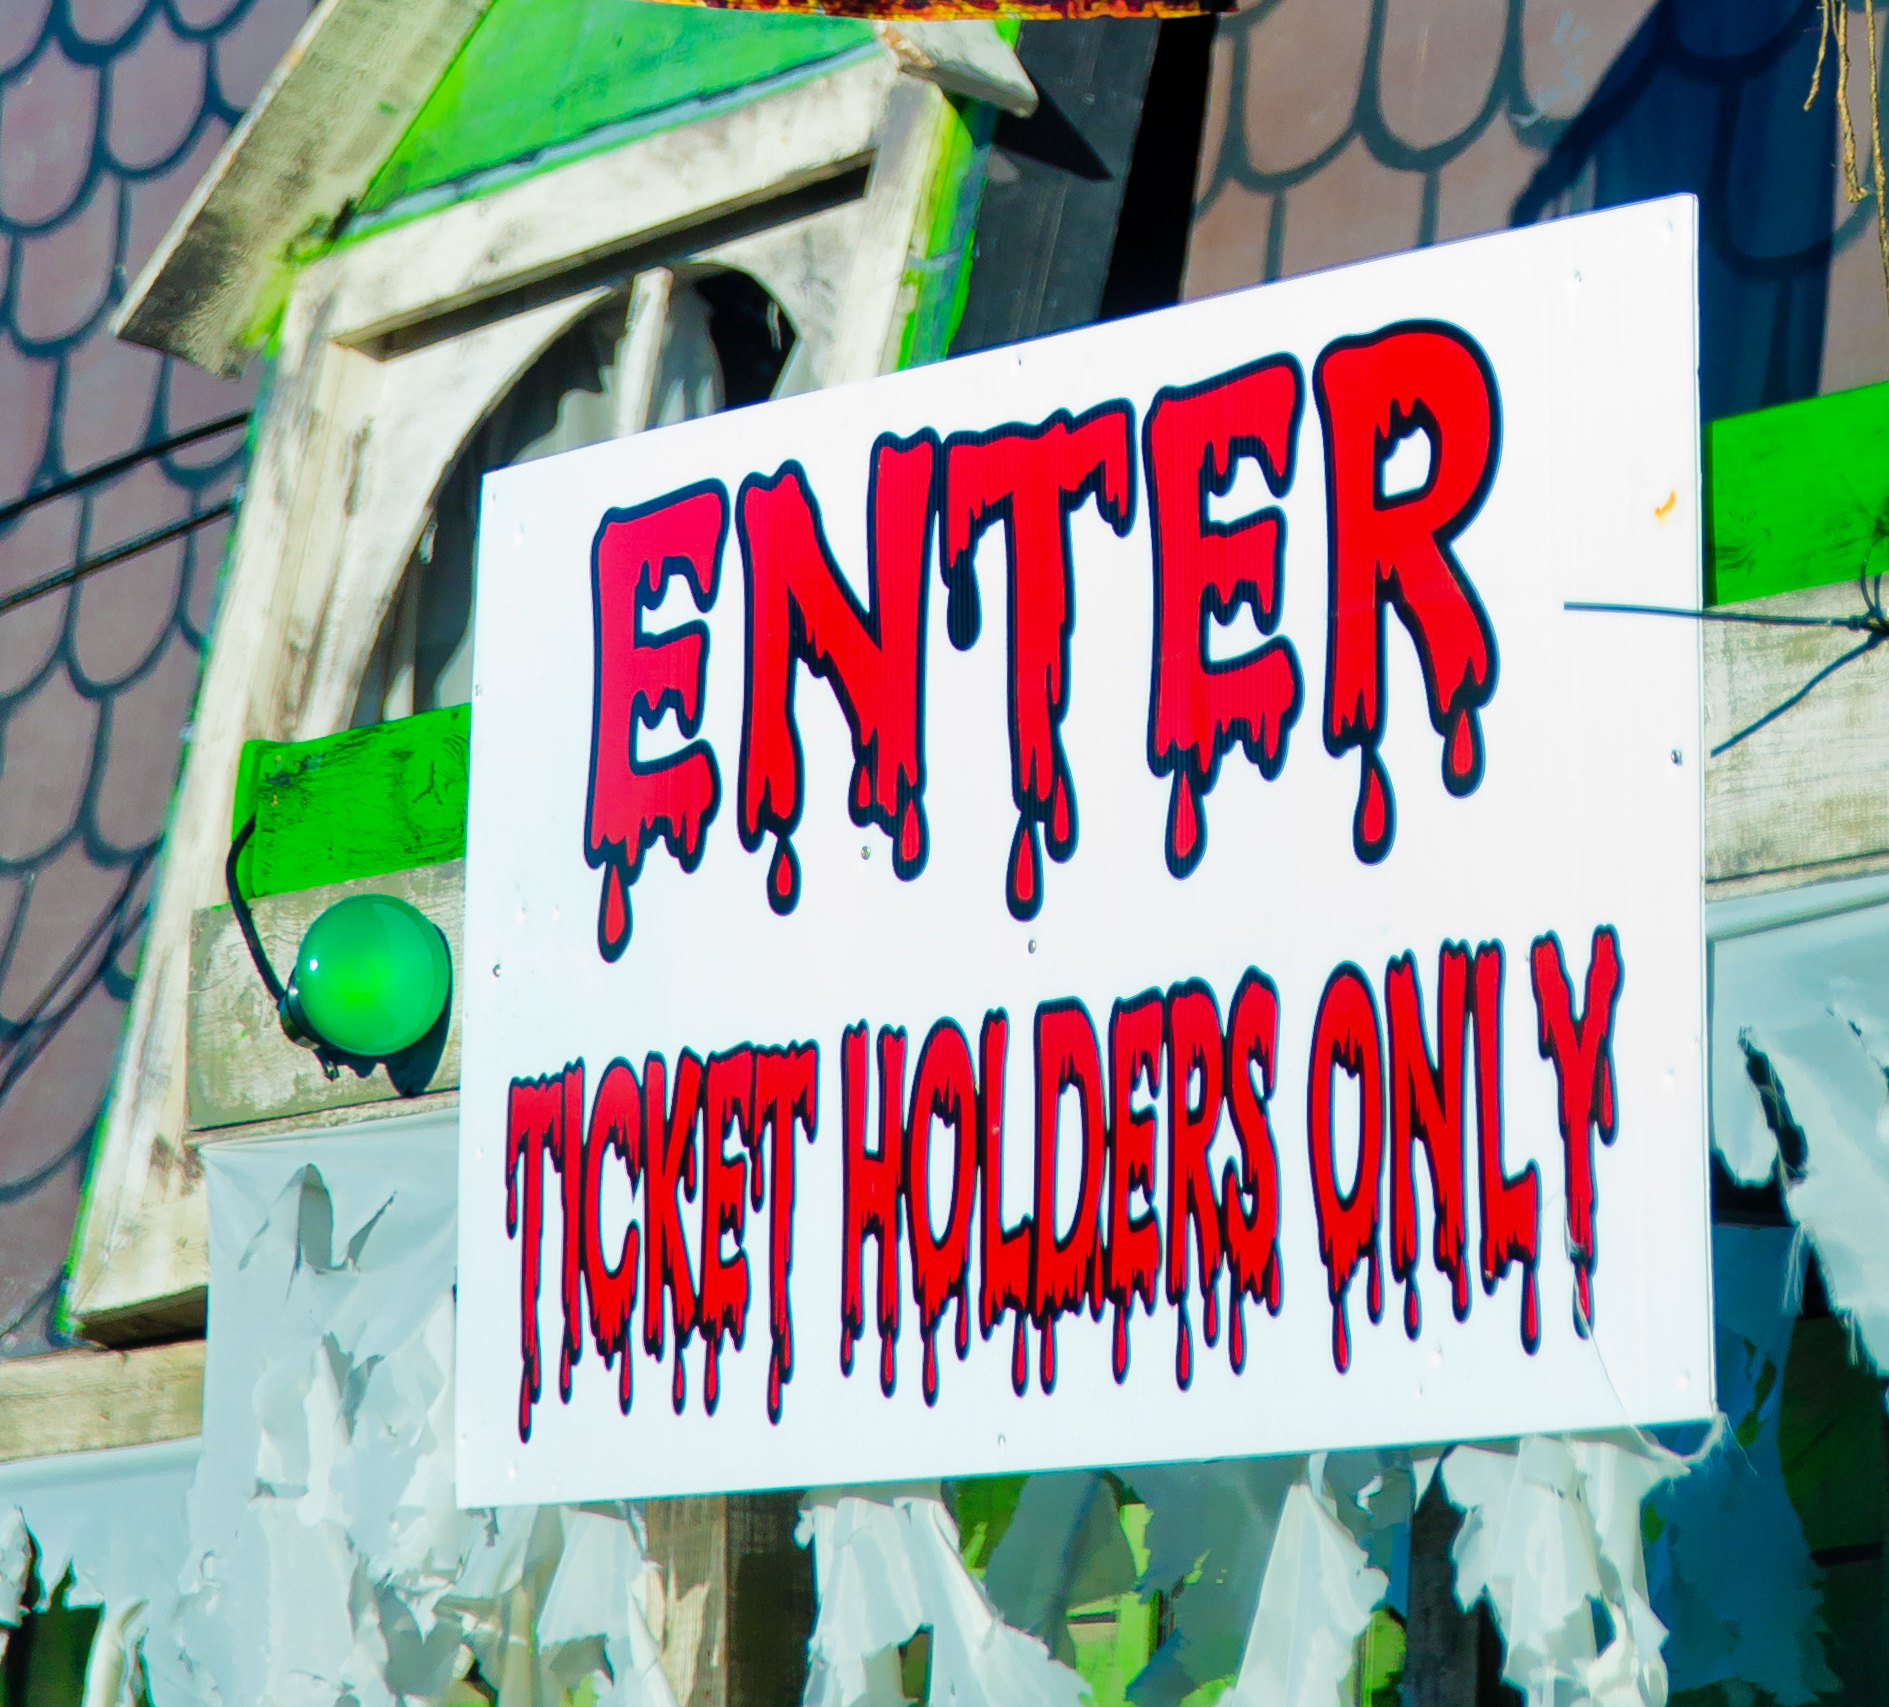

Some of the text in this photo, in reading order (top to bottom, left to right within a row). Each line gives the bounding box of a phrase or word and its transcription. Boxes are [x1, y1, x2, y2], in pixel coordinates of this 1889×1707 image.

[583, 319, 1502, 964] ENTER
[504, 926, 1623, 1444] TICKET HOLDERS ONLY
